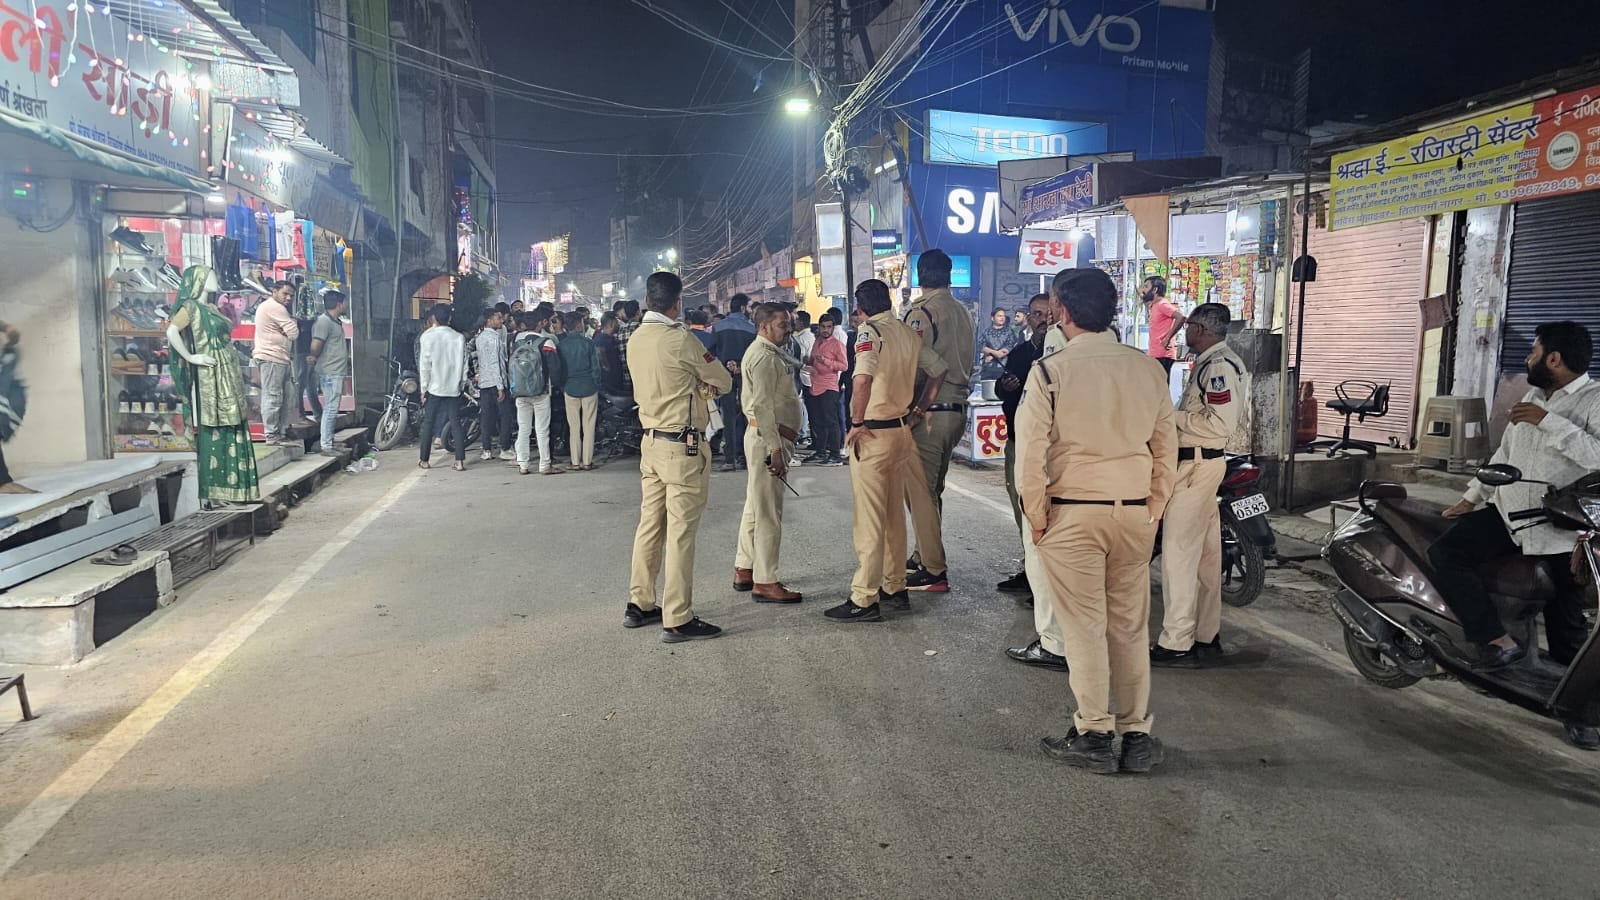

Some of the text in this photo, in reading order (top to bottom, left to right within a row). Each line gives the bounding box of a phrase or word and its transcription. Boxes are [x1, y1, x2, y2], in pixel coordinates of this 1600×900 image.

[1122, 55, 1154, 67] Pritam
[1336, 158, 1371, 179] श्रद्धा
[1487, 116, 1540, 145] सेंटर
[1495, 178, 1581, 199] 9399672849,
[1025, 240, 1074, 266] दूध
[1236, 501, 1268, 519] 0583
